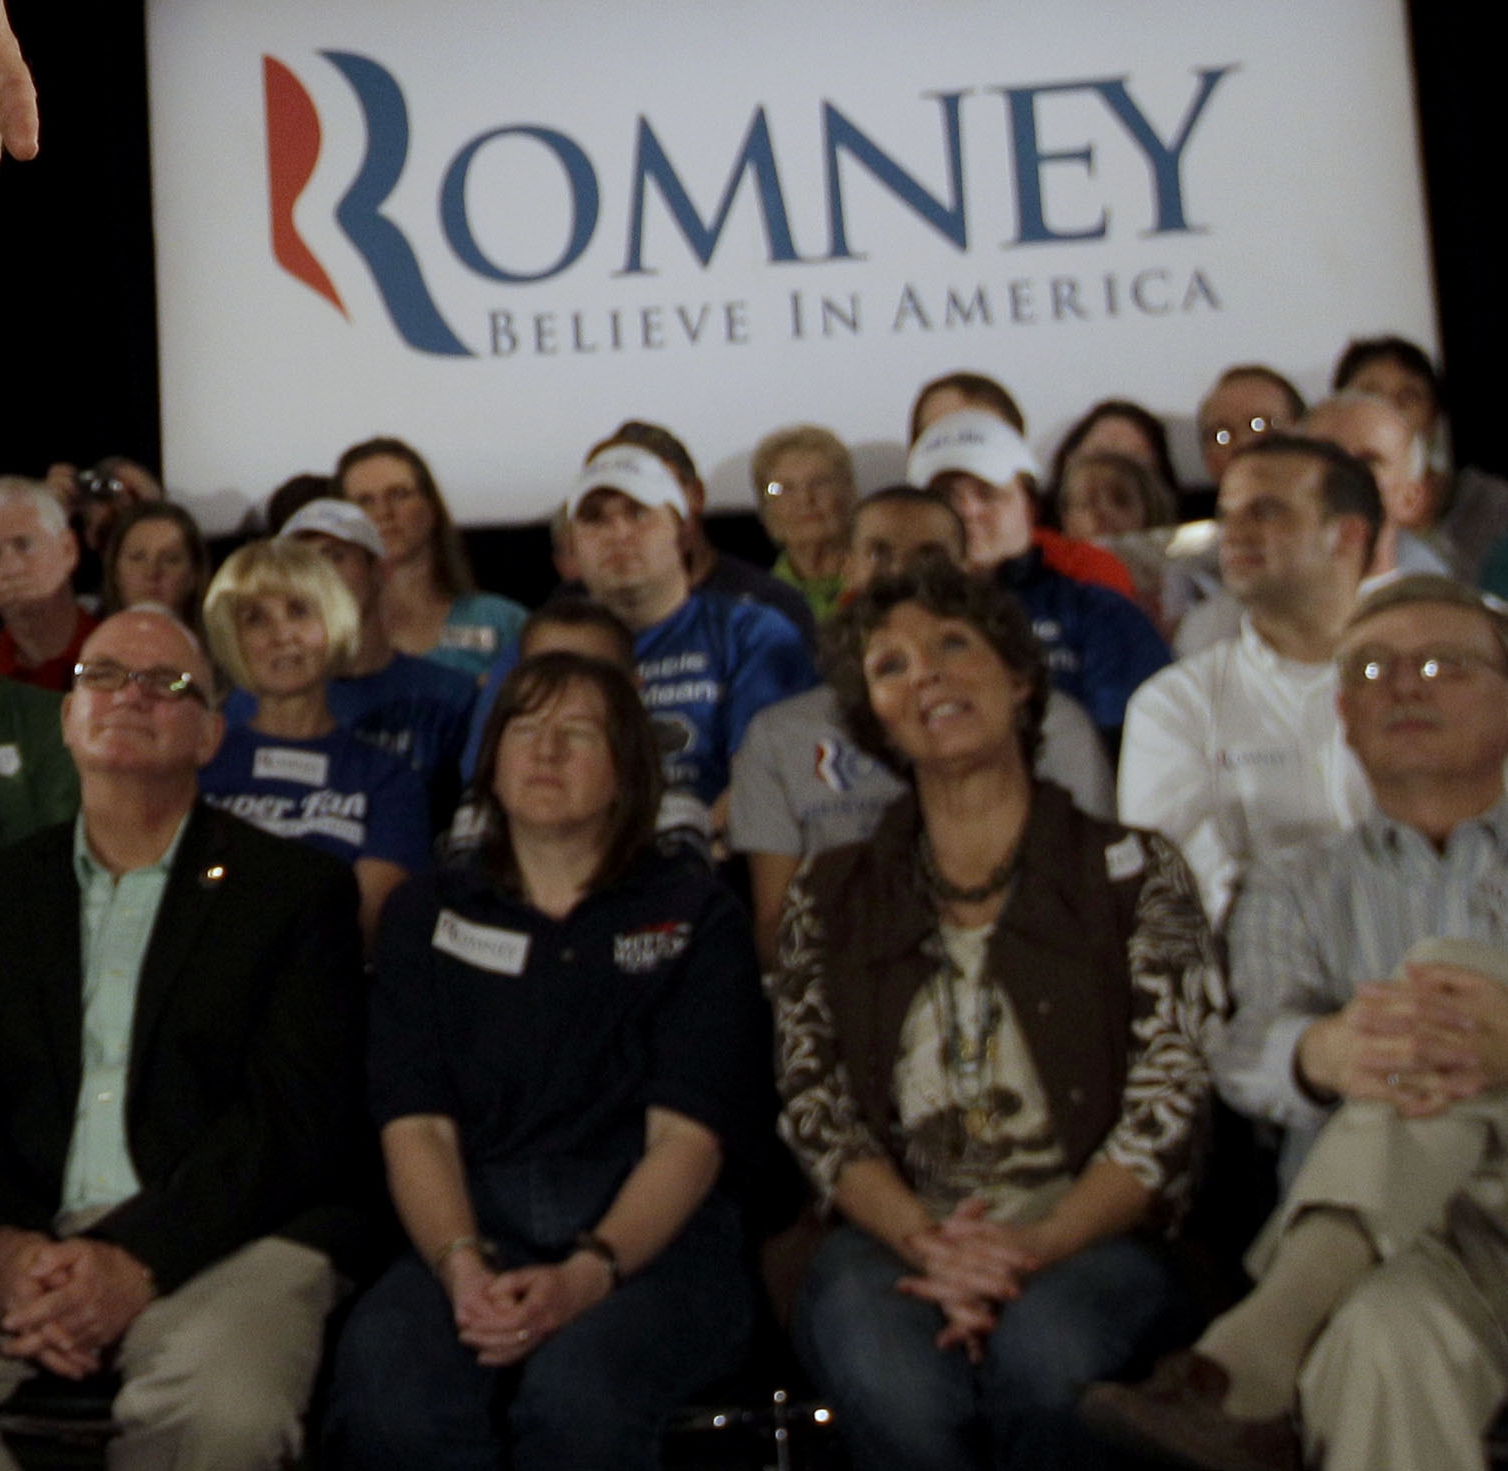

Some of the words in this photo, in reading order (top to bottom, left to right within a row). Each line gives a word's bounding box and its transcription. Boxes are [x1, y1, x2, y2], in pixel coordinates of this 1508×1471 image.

[261, 48, 1242, 358] ROMNEY
[488, 300, 752, 357] BELIEVE
[791, 289, 860, 340] IN
[892, 269, 1223, 331] AMERICA
